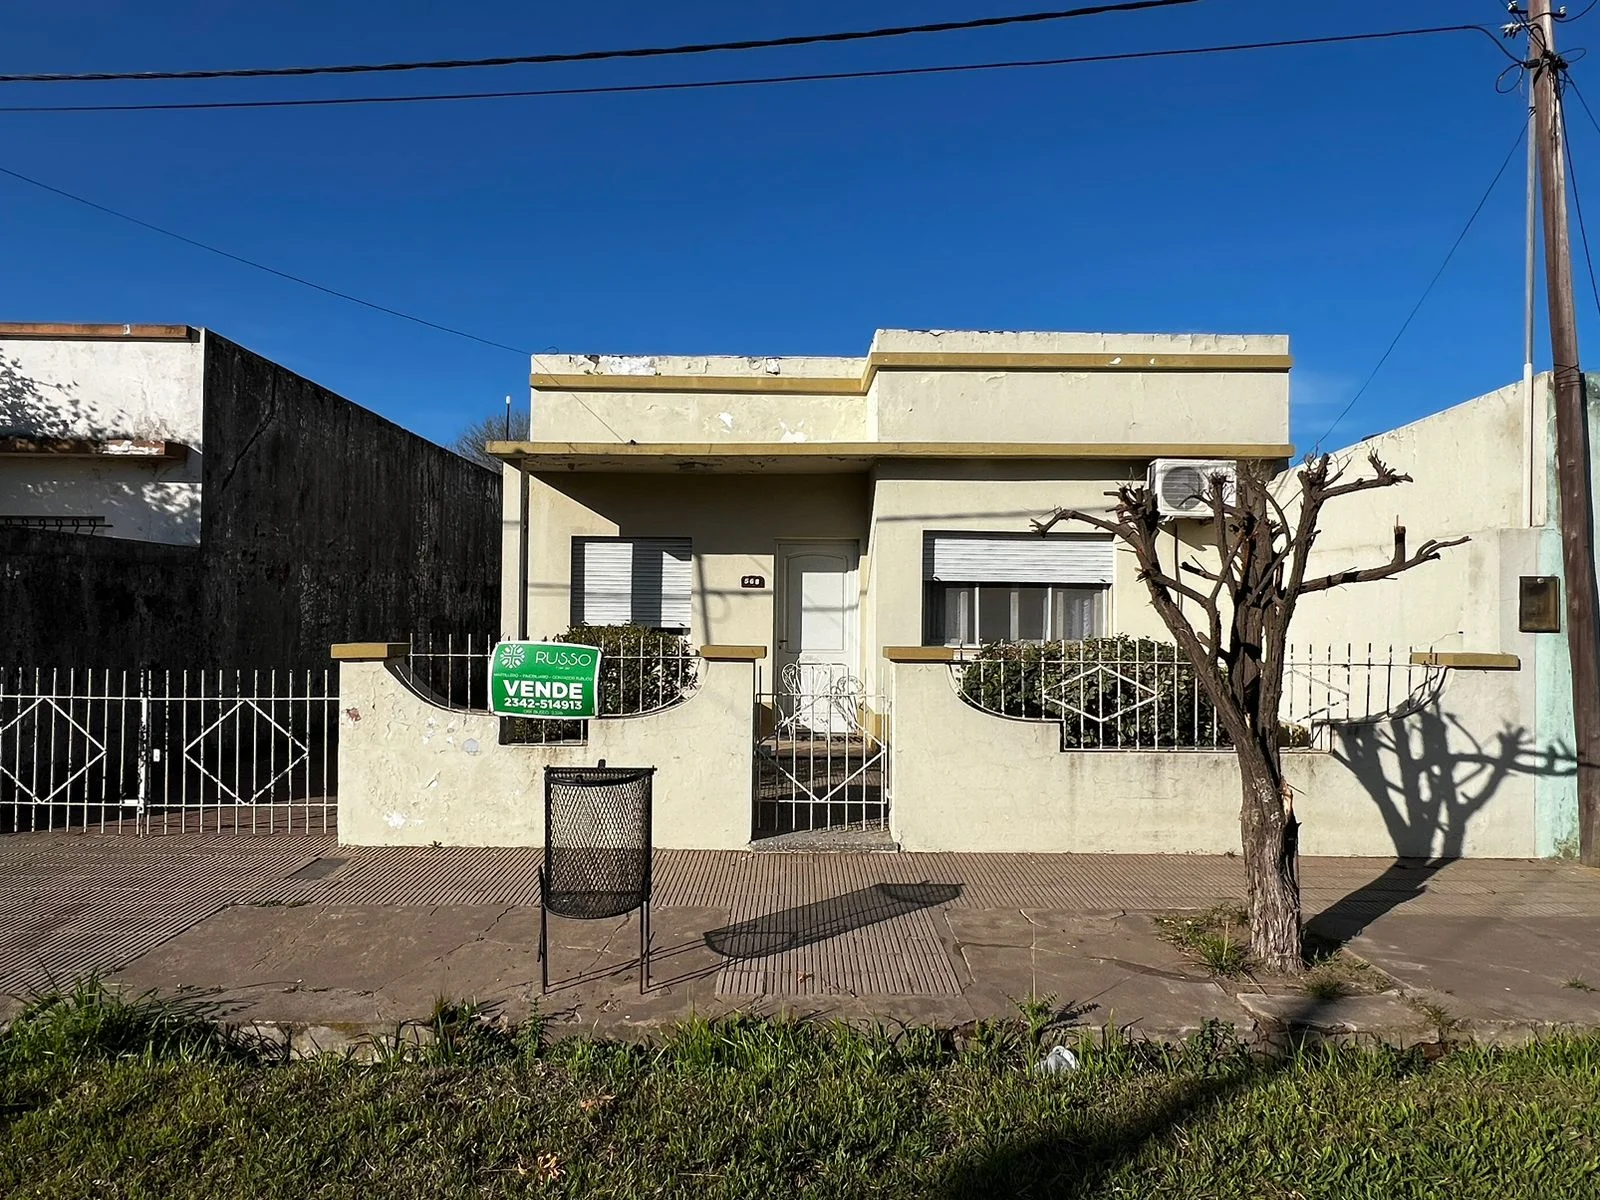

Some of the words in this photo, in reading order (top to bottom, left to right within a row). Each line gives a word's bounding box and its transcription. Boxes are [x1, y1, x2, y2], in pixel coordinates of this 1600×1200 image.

[535, 651, 592, 666] RUSSO
[503, 680, 583, 699] VENDE
[504, 698, 583, 710] 2342-514913
